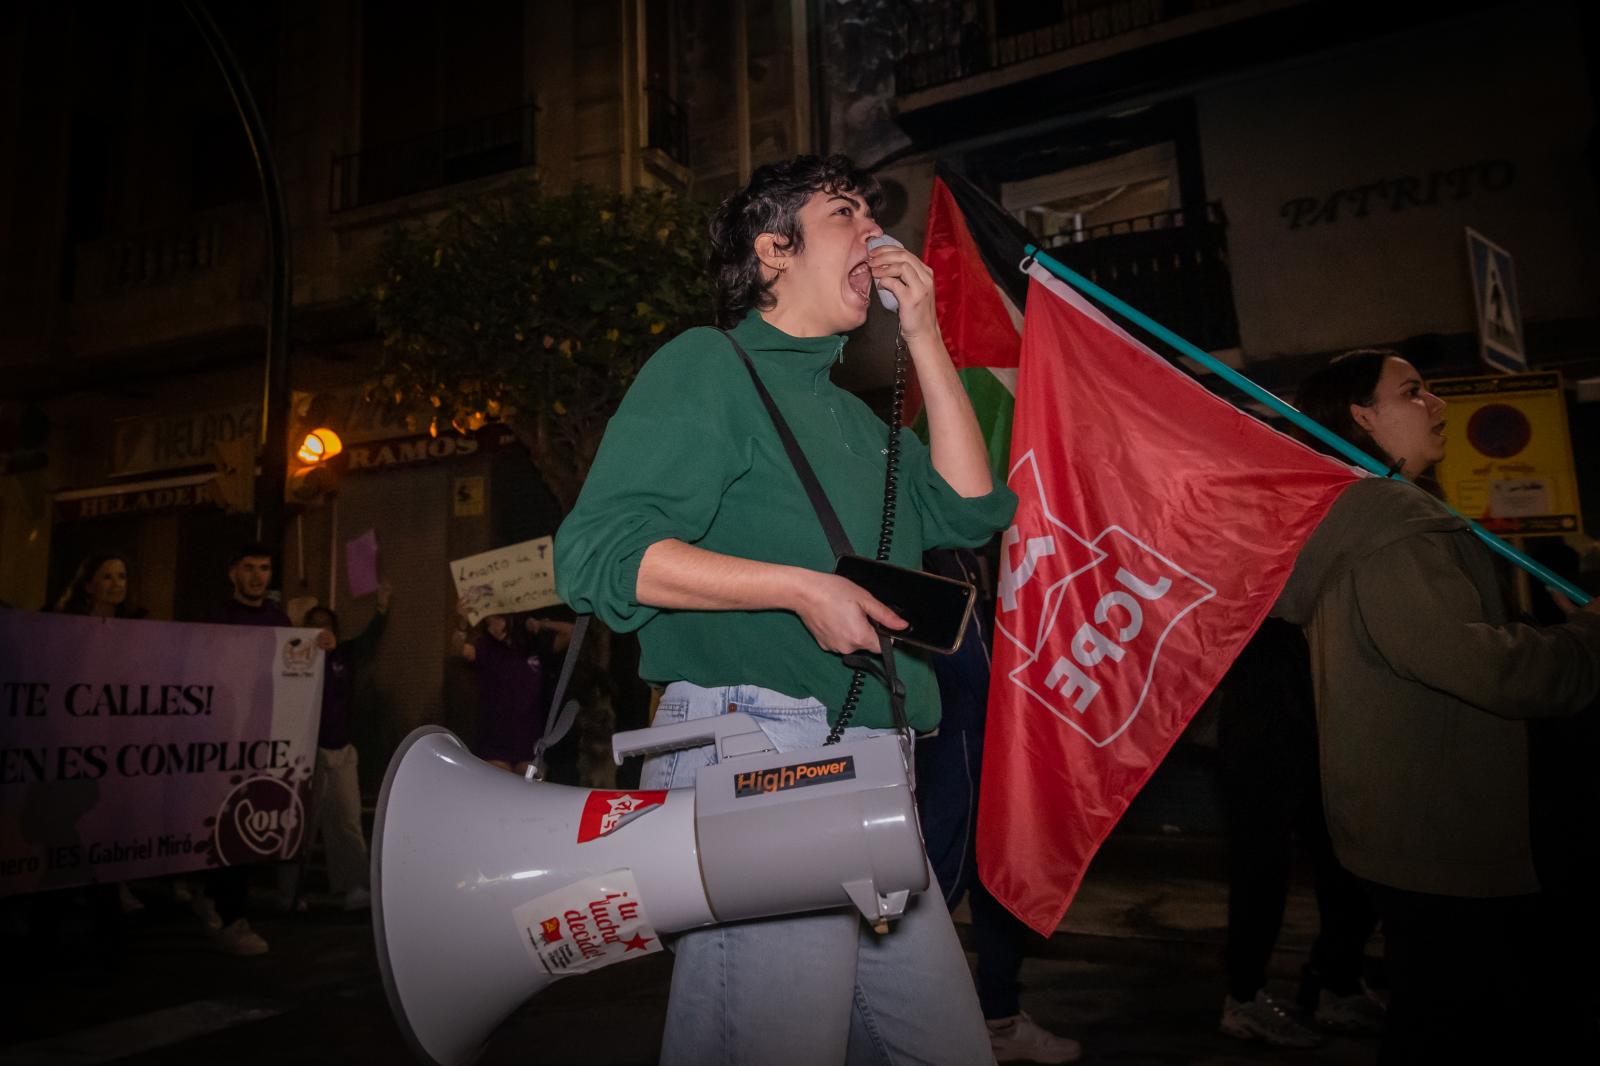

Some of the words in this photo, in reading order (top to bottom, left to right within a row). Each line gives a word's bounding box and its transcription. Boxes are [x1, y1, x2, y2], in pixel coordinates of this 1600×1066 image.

[347, 436, 479, 470] RAMOS
[3, 681, 51, 718] TE
[64, 682, 215, 718] CALLES!
[56, 745, 109, 781] ES
[88, 836, 153, 865] Gabriel
[564, 910, 607, 960] decide!
[588, 899, 622, 945] lucha
